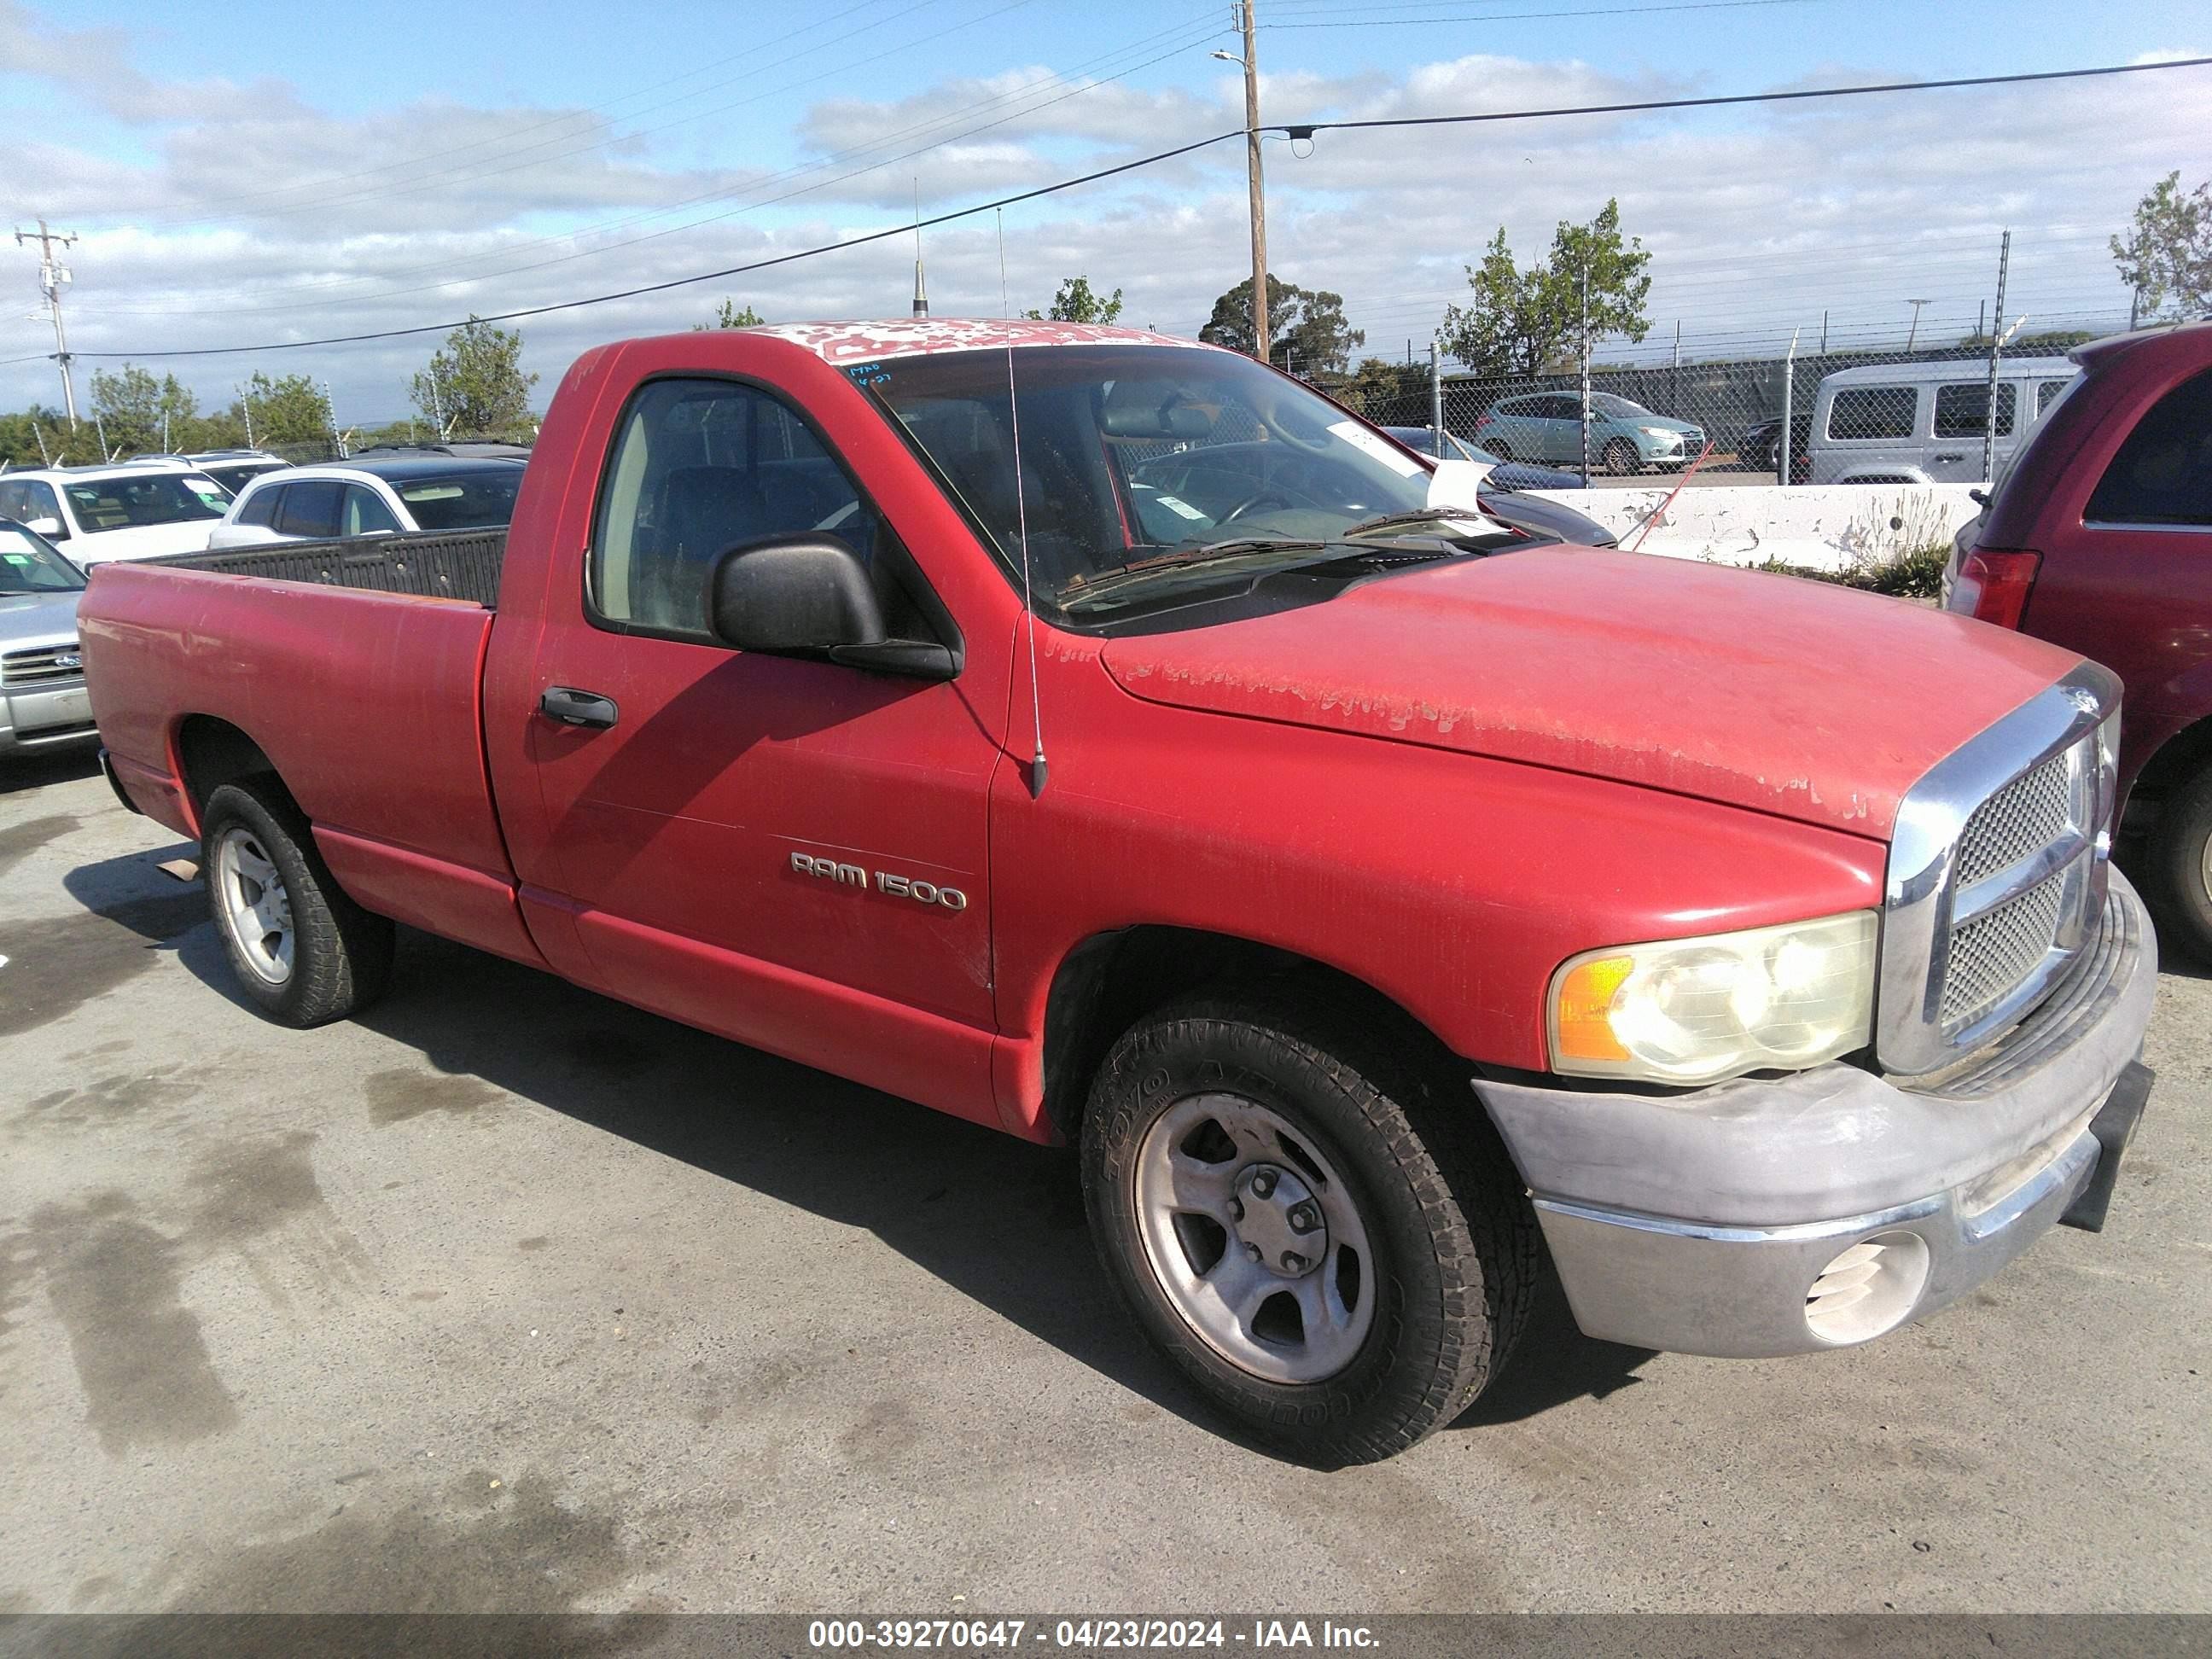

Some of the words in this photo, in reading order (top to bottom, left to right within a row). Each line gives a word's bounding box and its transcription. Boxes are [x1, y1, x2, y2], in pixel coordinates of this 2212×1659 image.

[790, 852, 867, 888] RAM
[875, 871, 968, 911] 1500
[1099, 1067, 1170, 1182] TOYO
